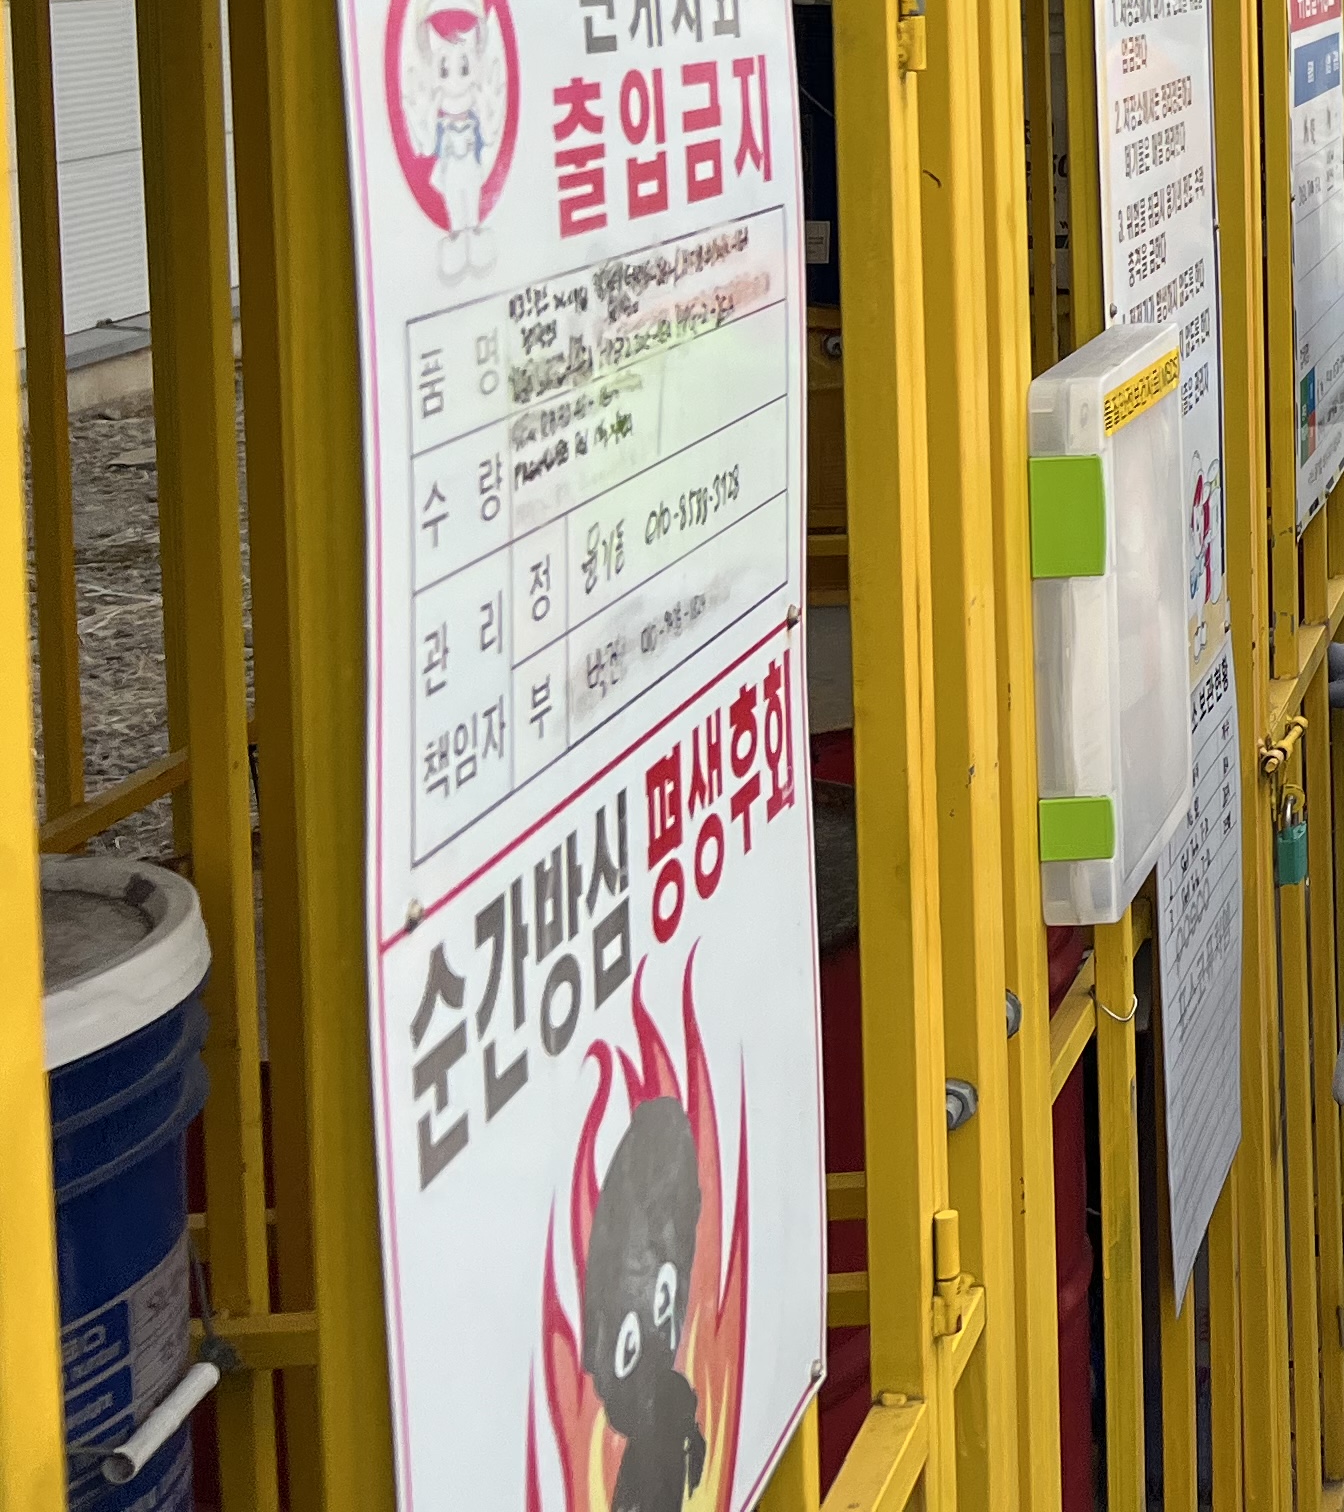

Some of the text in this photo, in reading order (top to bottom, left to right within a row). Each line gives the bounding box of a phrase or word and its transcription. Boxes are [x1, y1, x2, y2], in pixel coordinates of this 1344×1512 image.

[552, 54, 772, 241] 출입금지
[475, 331, 498, 395] 명
[530, 561, 552, 622] 정
[423, 589, 503, 697] 관 리
[530, 680, 552, 739] 부
[1199, 655, 1229, 722] 보관현황
[423, 696, 506, 799] 책임자
[411, 785, 631, 1190] 순간방심
